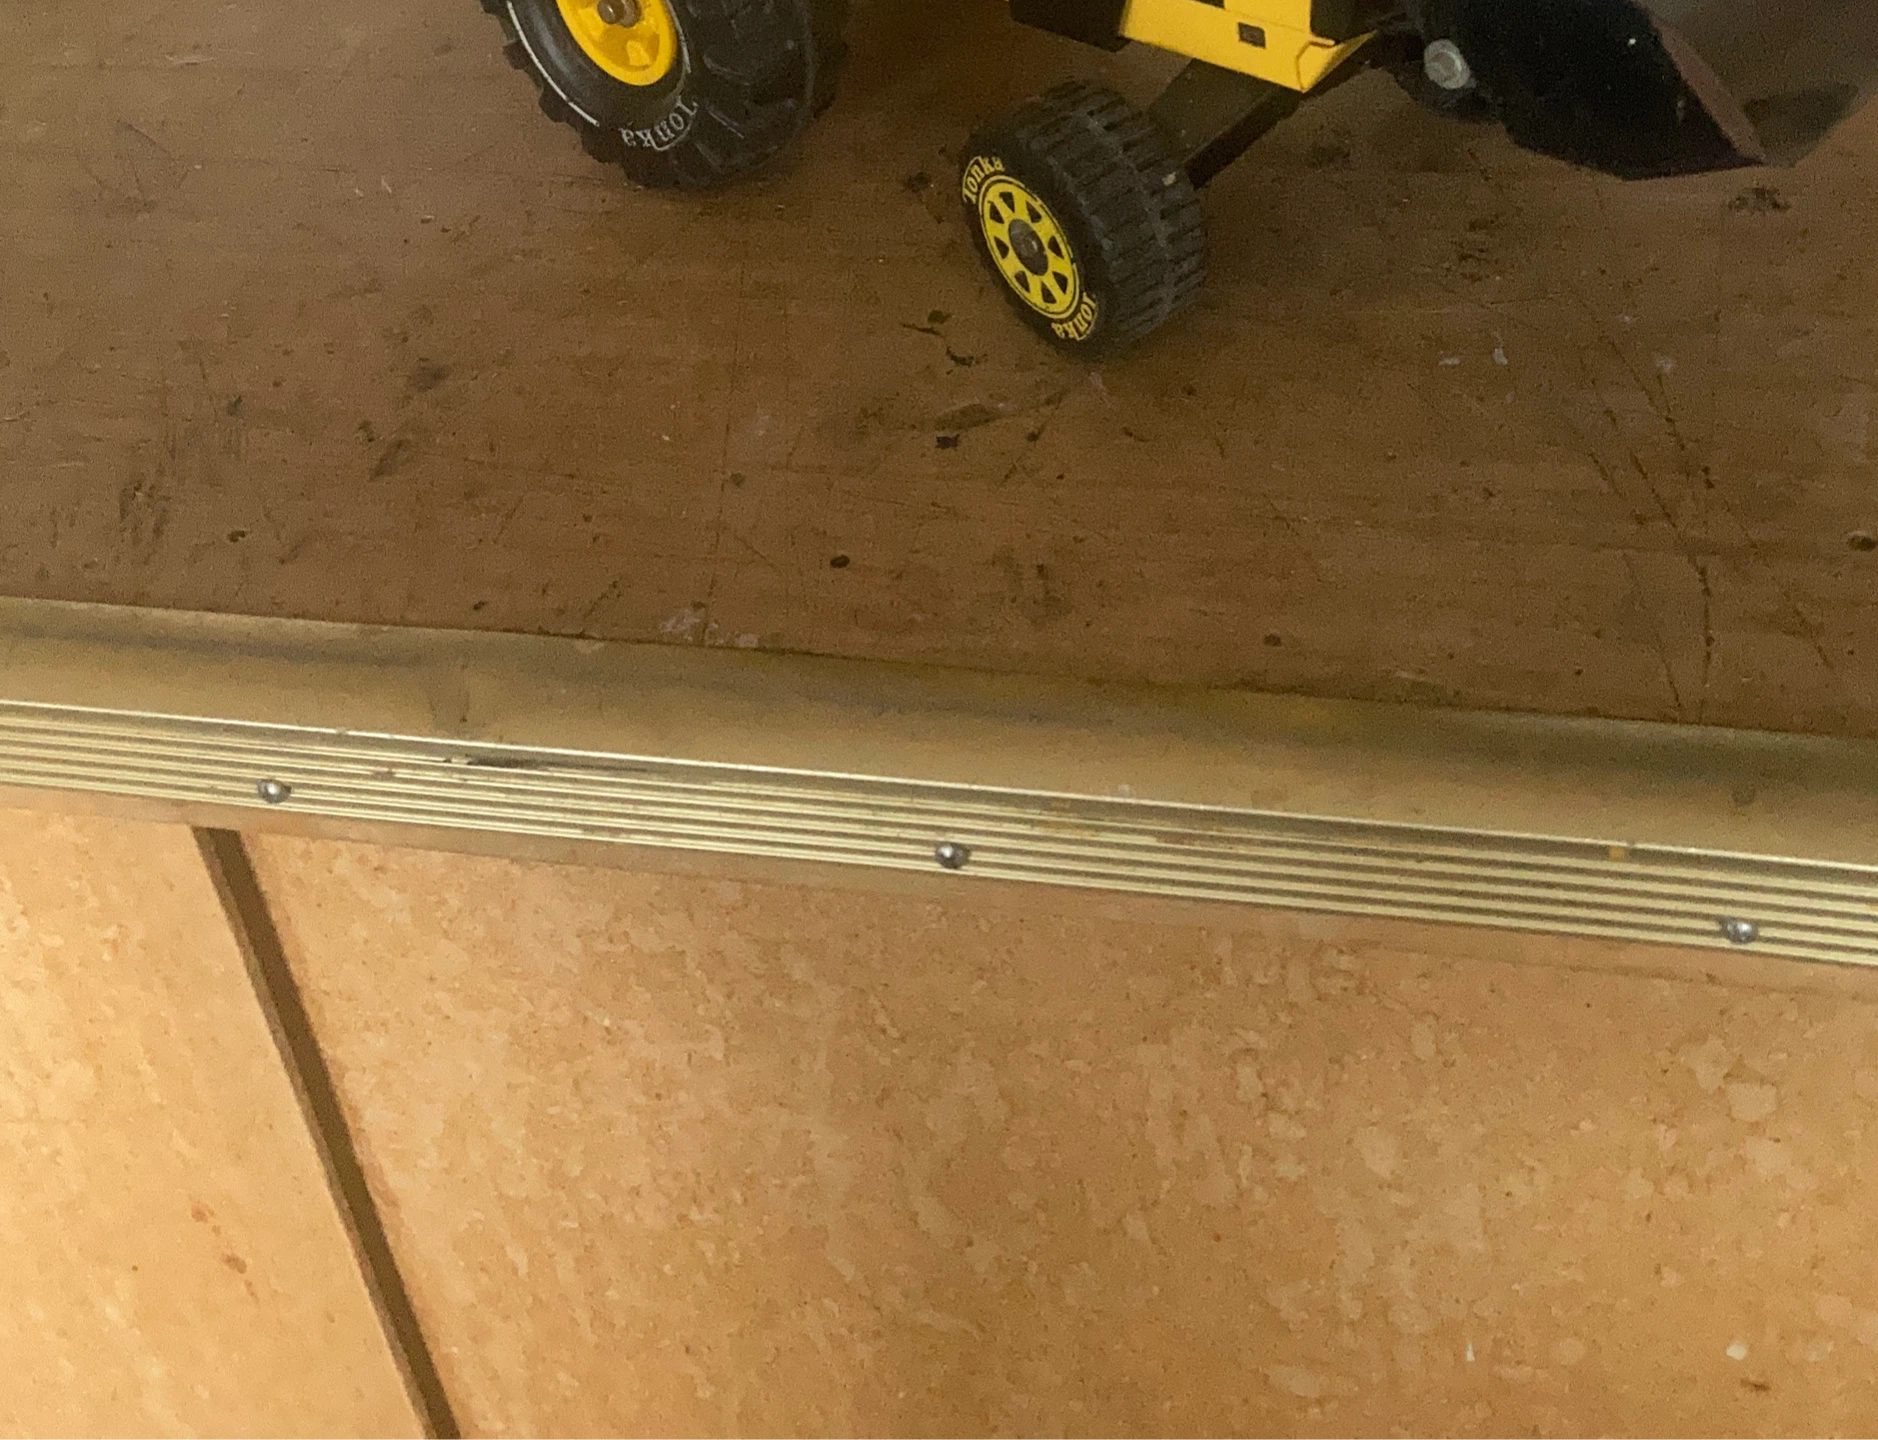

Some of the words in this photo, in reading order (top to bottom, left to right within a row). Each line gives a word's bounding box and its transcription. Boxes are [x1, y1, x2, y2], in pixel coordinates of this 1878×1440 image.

[619, 93, 699, 153] Tonka
[962, 156, 1006, 205] Tonka
[1051, 291, 1098, 341] Tonka
